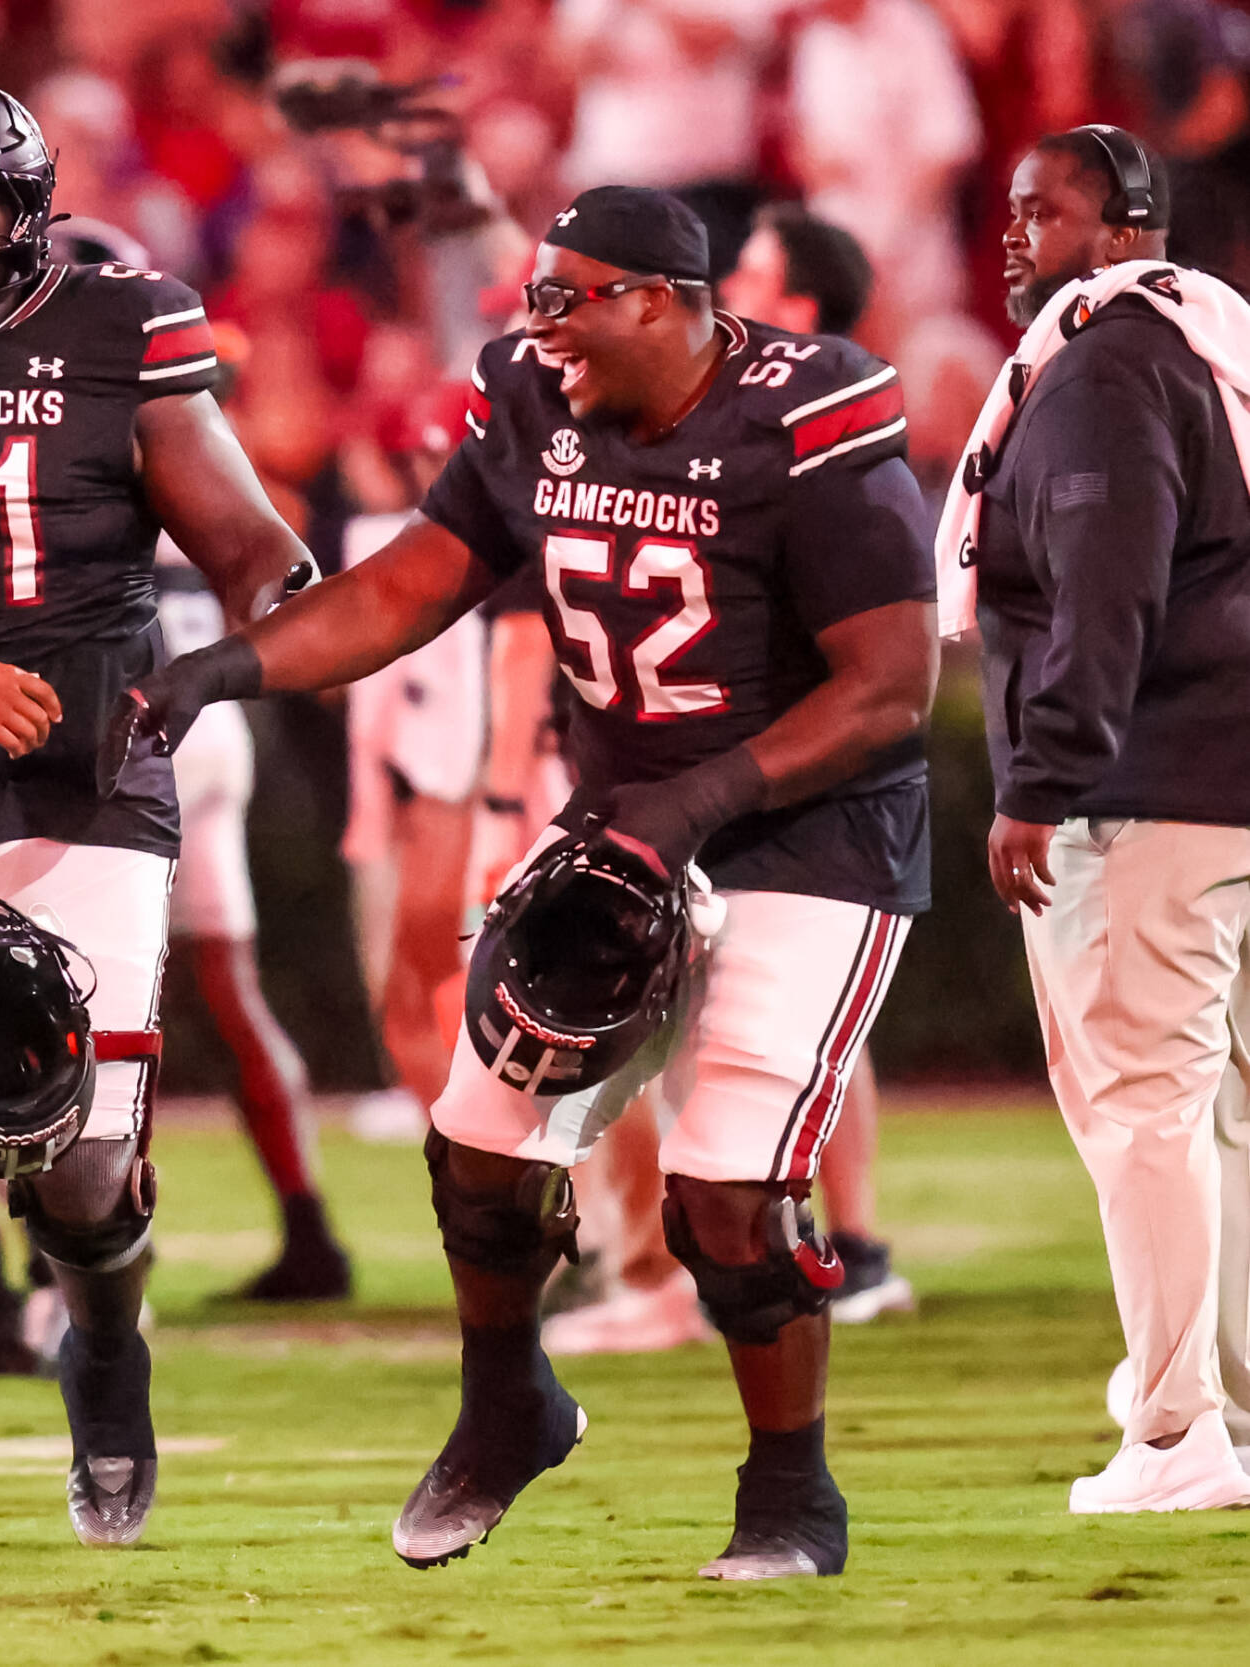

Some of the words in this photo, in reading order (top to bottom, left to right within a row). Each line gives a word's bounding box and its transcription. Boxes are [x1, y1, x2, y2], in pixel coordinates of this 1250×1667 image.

[738, 341, 822, 388] 52
[551, 428, 581, 463] SEC
[533, 478, 721, 537] GAMECOCKS
[542, 529, 730, 721] 52
